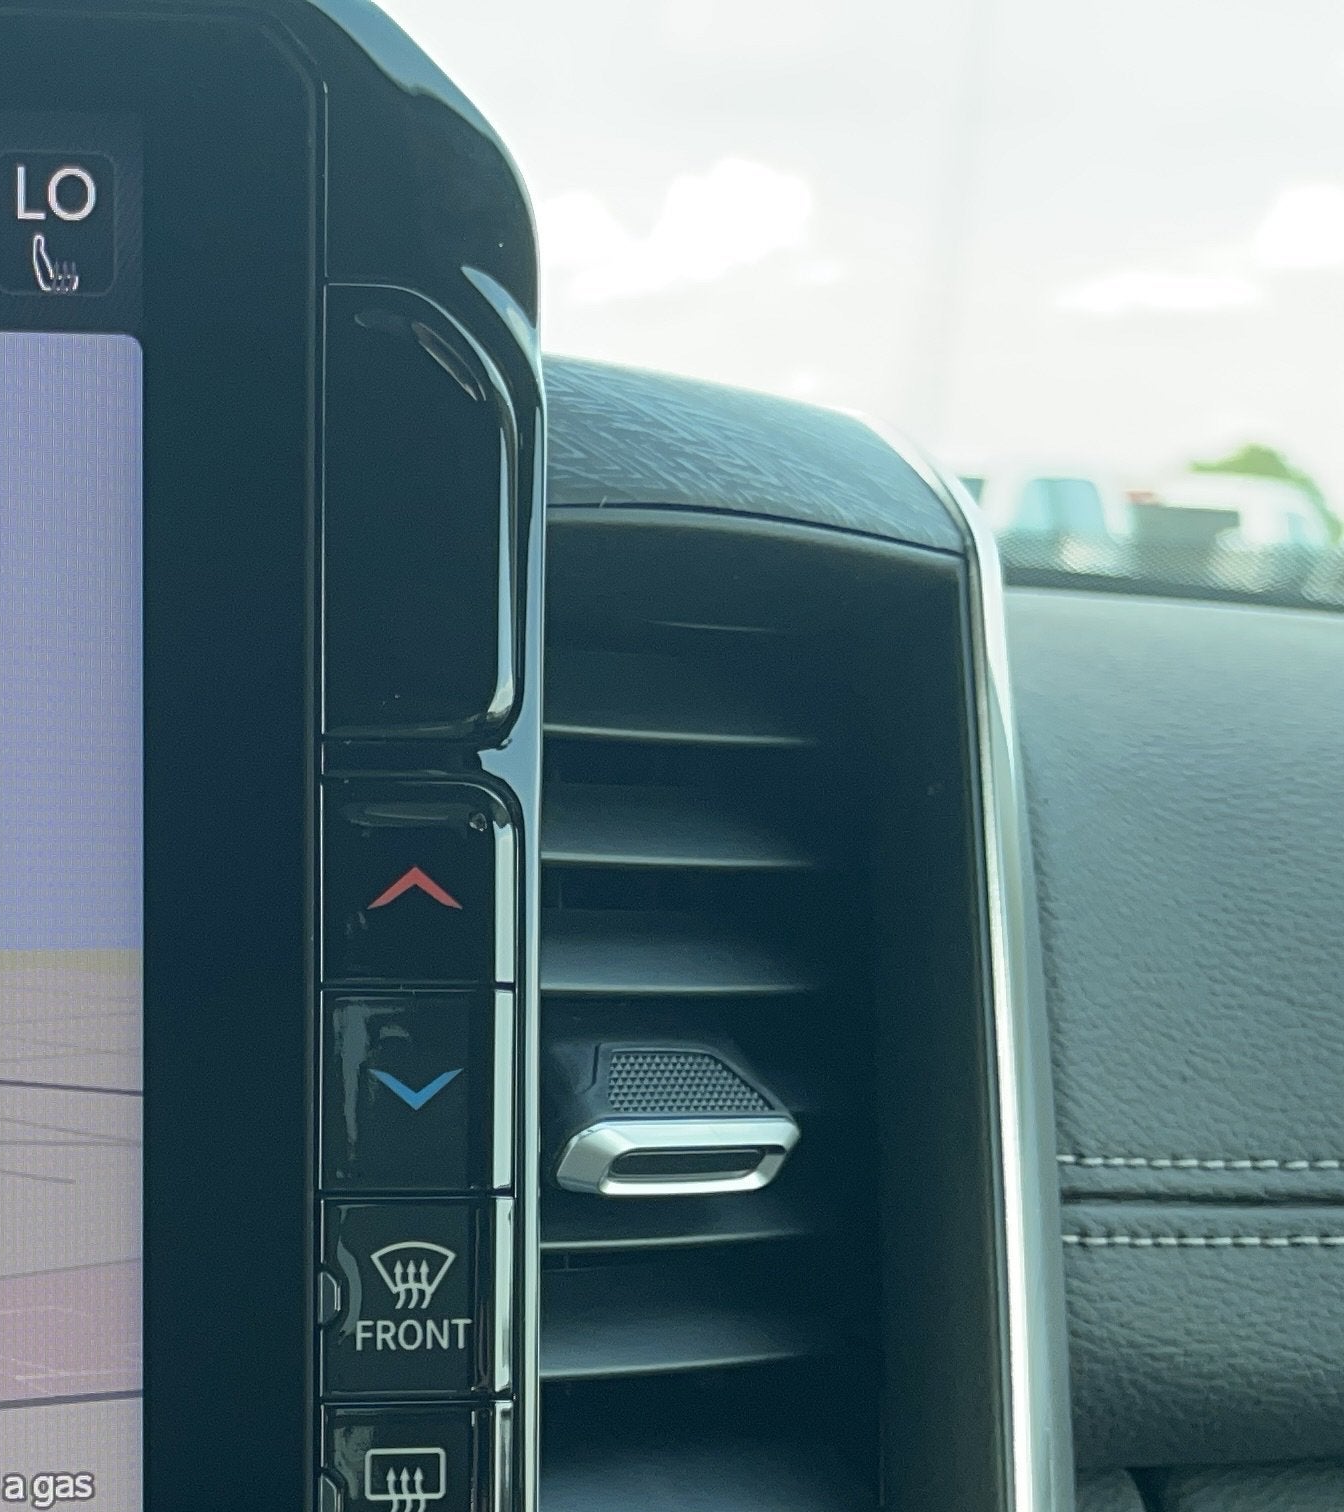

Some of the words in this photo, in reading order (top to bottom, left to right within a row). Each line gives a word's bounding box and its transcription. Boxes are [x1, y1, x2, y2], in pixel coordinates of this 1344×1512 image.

[15, 165, 97, 223] LO
[355, 1318, 473, 1351] FRONT
[4, 1477, 24, 1500] a
[32, 1472, 94, 1507] gas
